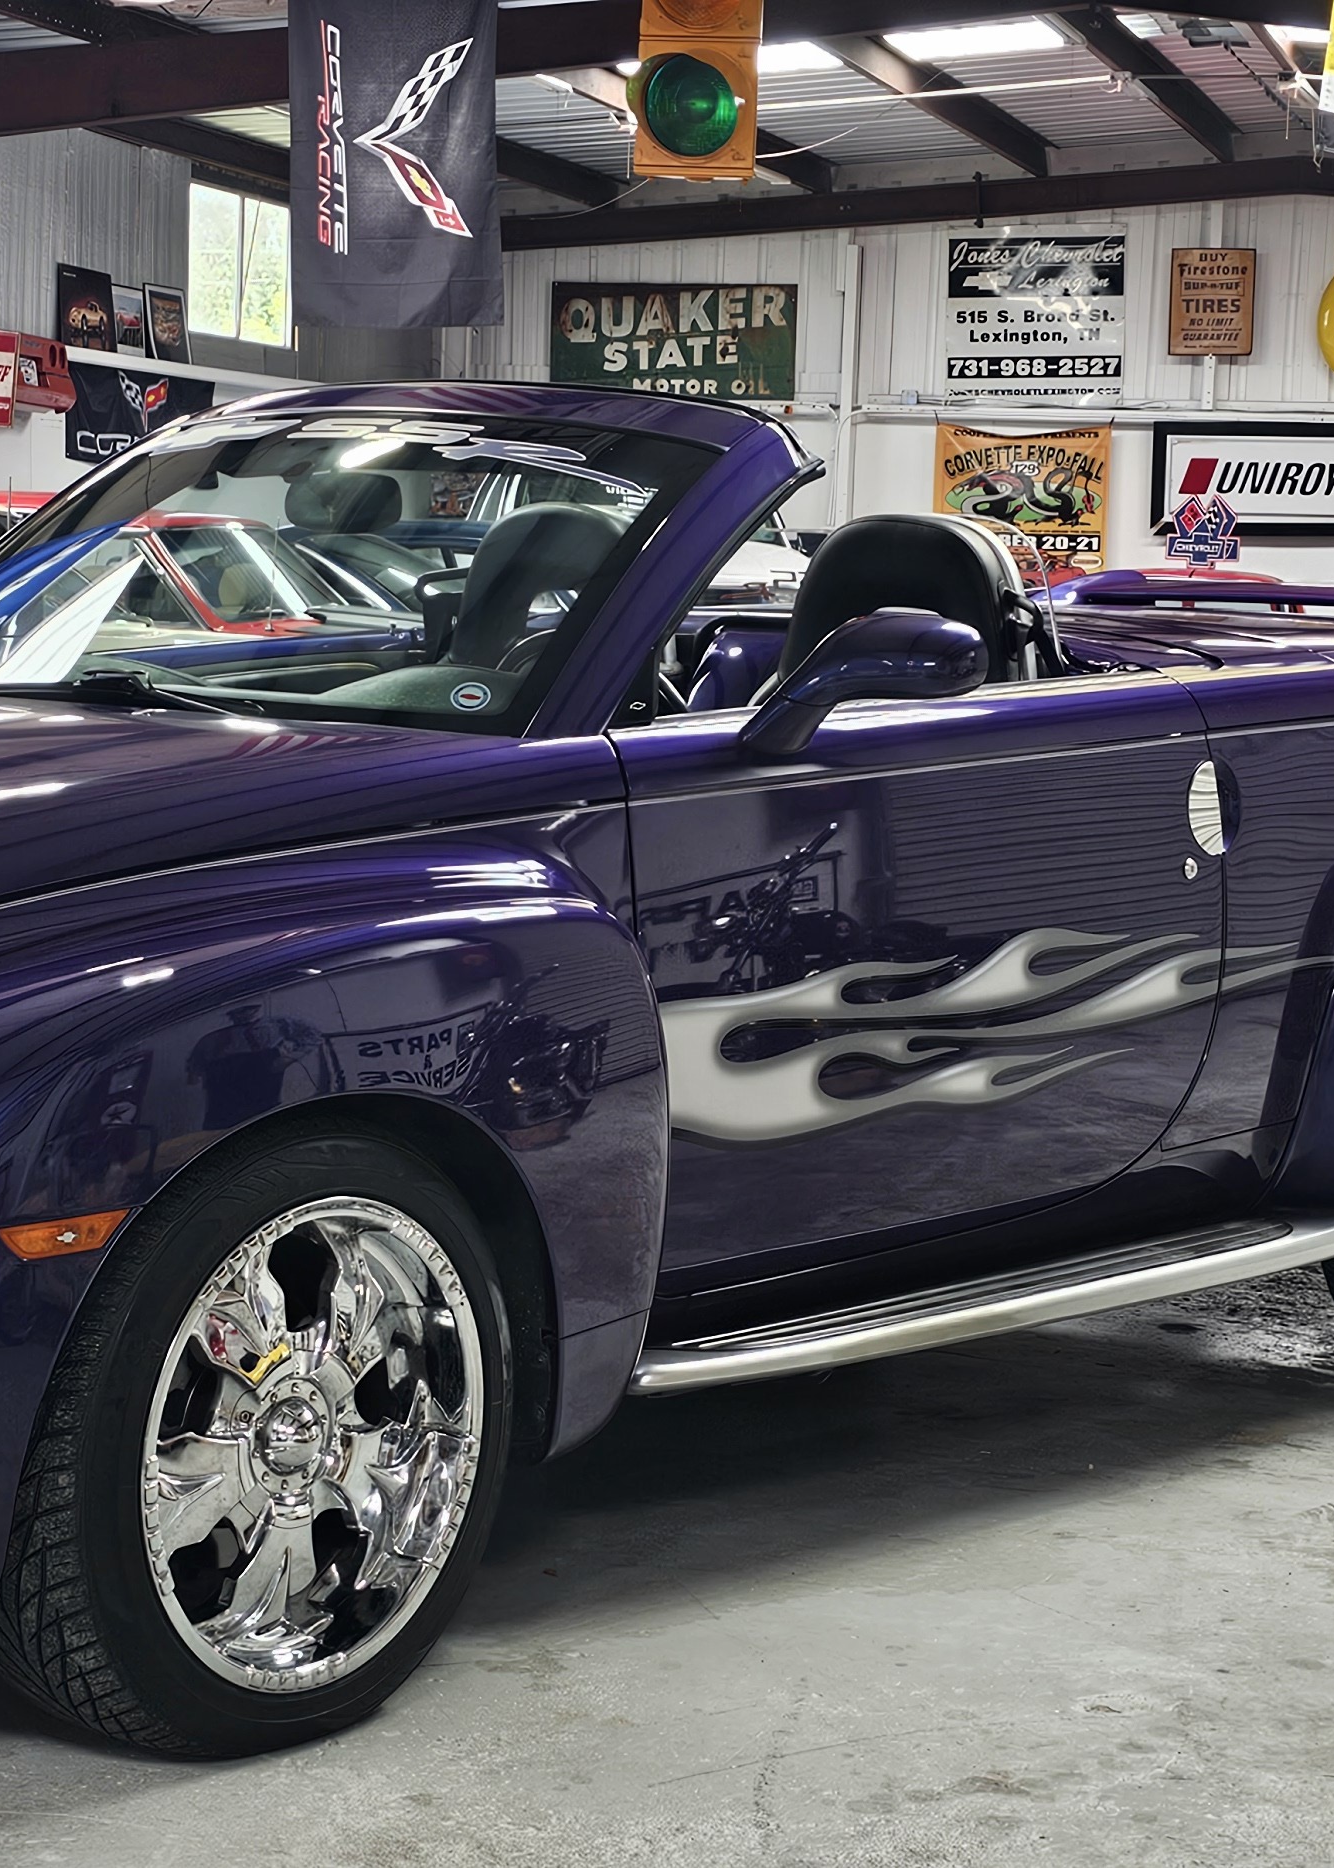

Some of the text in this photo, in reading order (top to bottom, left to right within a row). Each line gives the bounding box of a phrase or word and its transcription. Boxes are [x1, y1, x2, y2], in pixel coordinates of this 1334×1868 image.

[326, 24, 349, 256] CORVETTE
[317, 94, 332, 246] RACING
[950, 240, 1124, 272] Jones Chevrolet
[1199, 253, 1228, 262] BUY
[1177, 263, 1248, 277] Firestone
[1017, 271, 1111, 293] Lexington
[559, 286, 788, 343] QUAKER
[1181, 299, 1241, 313] TIRES
[956, 311, 988, 324] 515
[997, 310, 1015, 323] S.
[1089, 309, 1116, 322] St.
[1206, 318, 1235, 327] LIMIT
[969, 329, 1068, 345] Lexington,
[603, 335, 739, 371] STATE
[950, 358, 1120, 377] 731-968-2527
[632, 377, 718, 395] MOTOR
[945, 445, 1105, 481] CORVETTE EXPO FALL
[1041, 536, 1099, 551] 20-21
